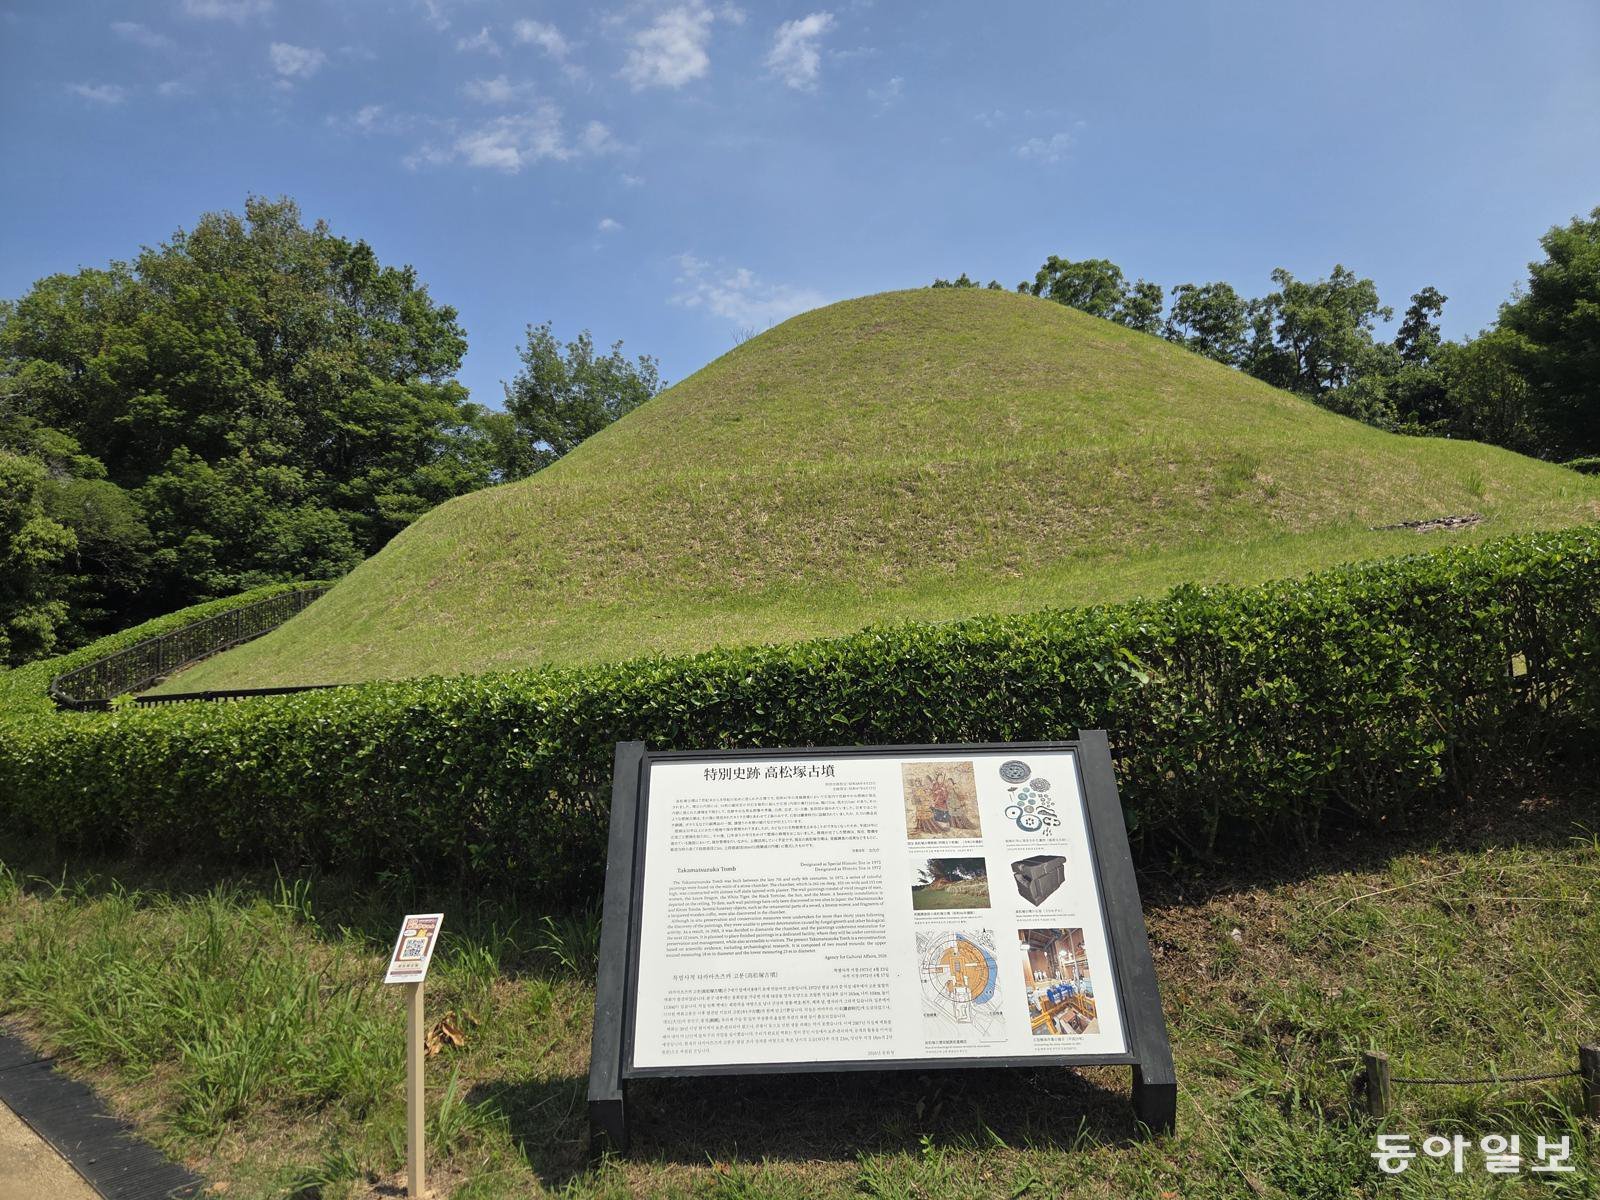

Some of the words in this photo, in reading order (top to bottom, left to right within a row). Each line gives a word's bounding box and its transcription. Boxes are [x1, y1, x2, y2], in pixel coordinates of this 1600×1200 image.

[704, 767, 760, 781] 特別史跡
[764, 764, 836, 780] 高松塚古墳
